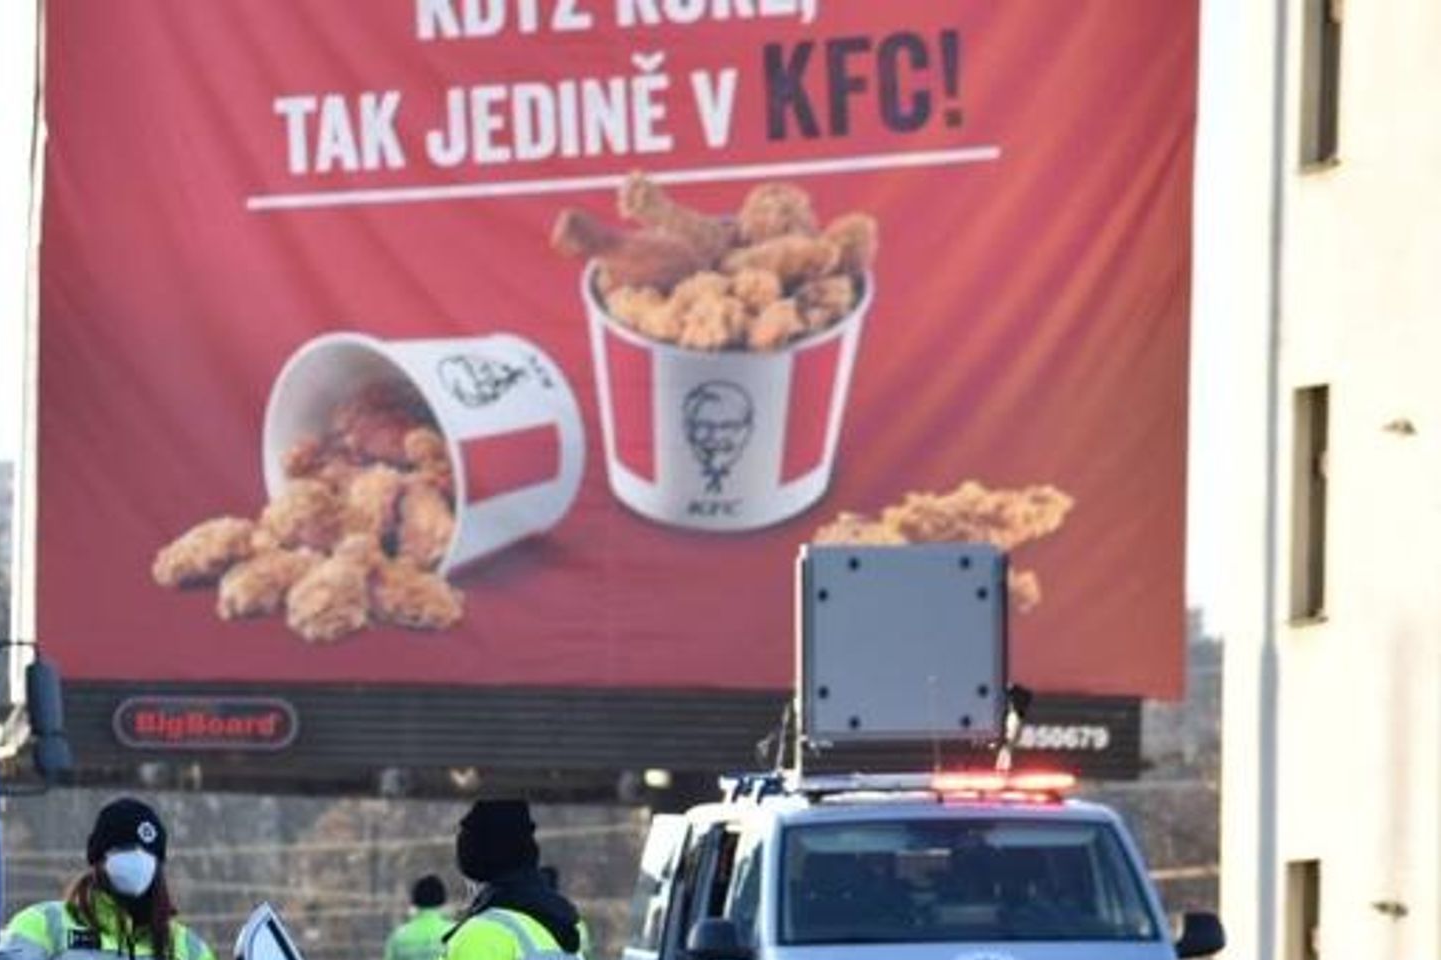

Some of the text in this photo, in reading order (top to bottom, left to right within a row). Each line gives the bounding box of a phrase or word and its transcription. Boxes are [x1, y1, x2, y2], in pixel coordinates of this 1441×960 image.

[274, 29, 963, 174] TAK JEDINĚ V KFC!
[135, 712, 282, 743] BigBoard
